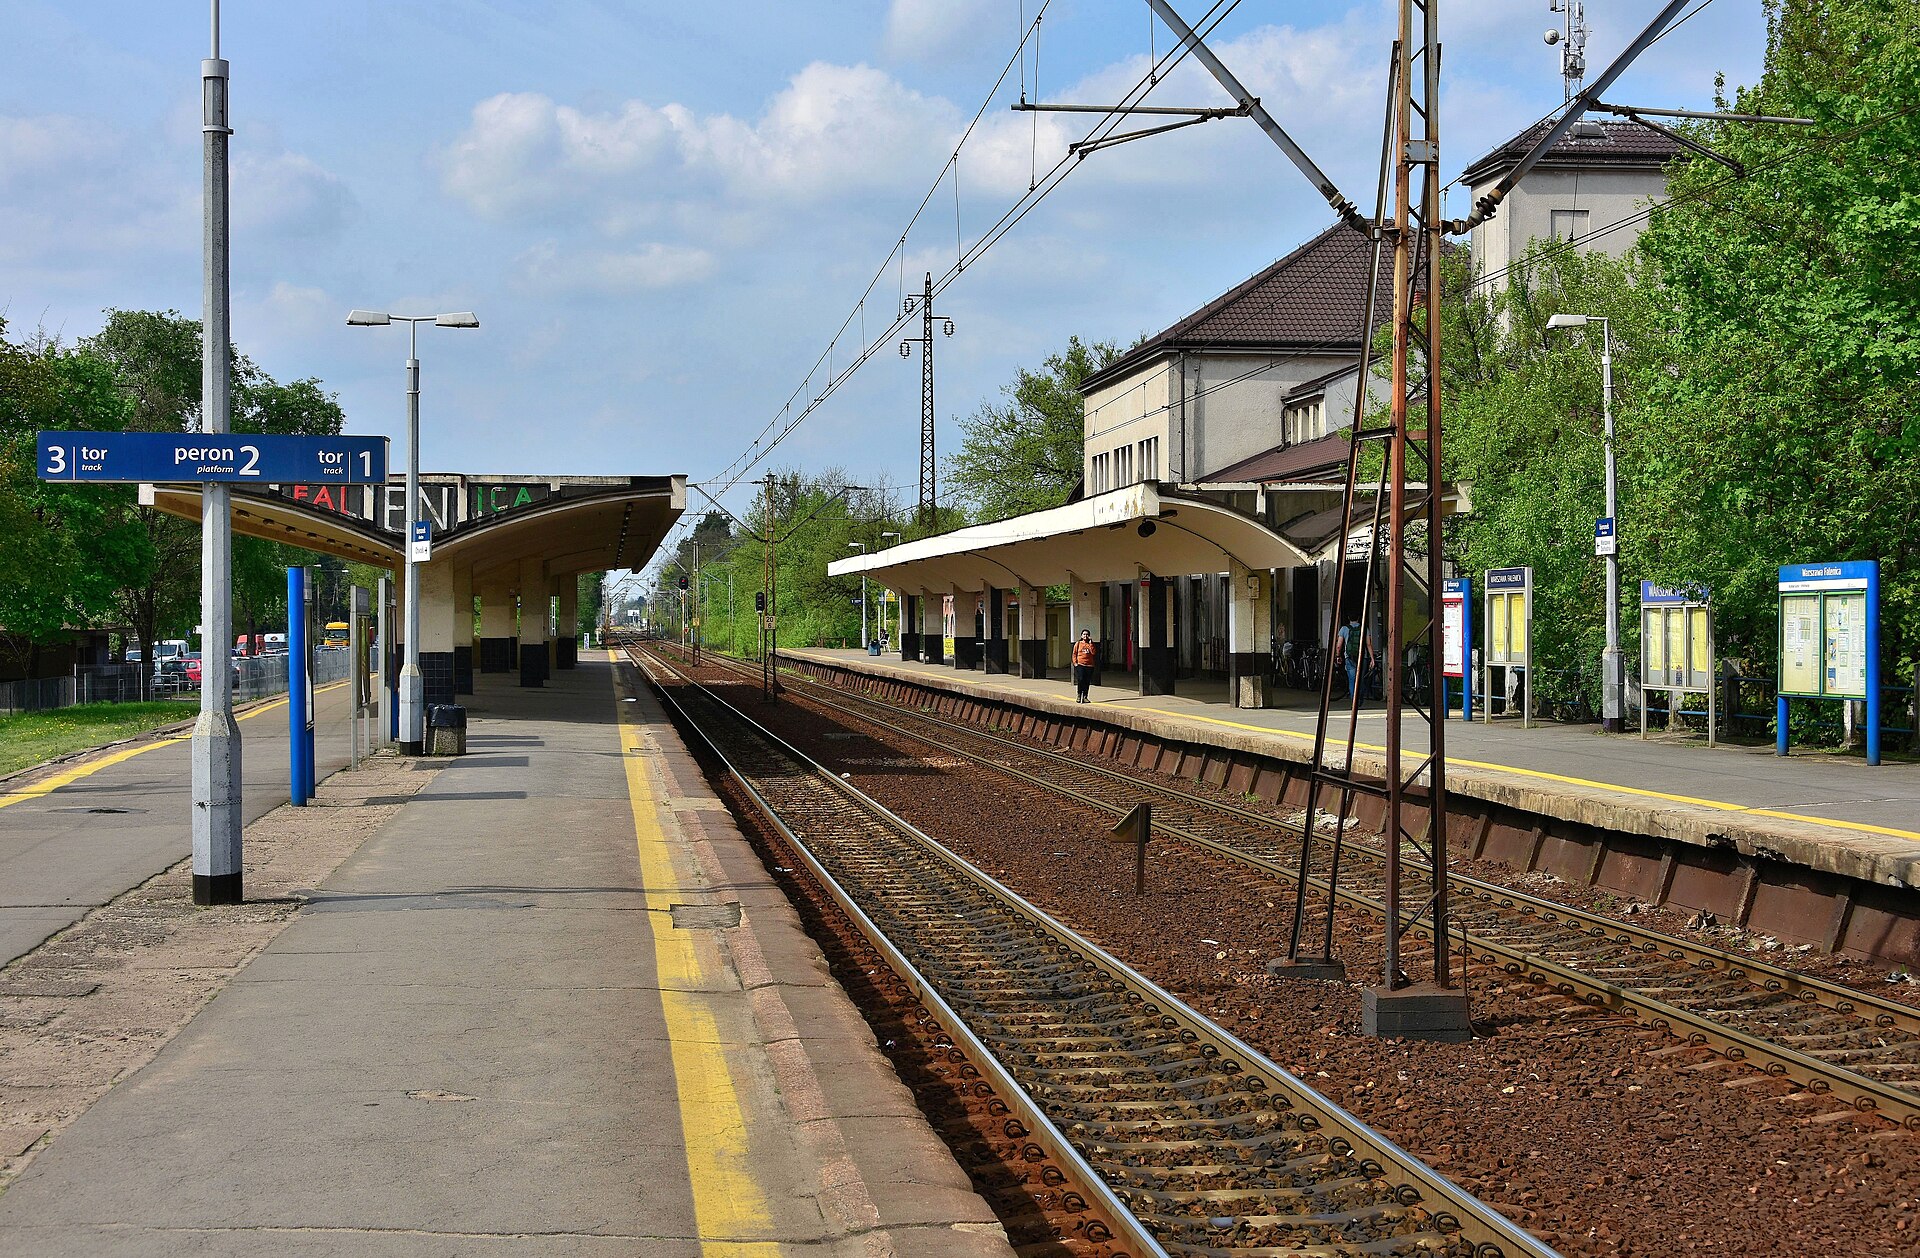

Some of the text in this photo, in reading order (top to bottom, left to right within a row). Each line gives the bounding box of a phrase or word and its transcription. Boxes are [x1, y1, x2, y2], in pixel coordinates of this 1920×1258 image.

[47, 446, 108, 473] 3 tor
[174, 445, 260, 476] peron 2
[197, 465, 233, 474] platform
[318, 450, 371, 477] tor 1
